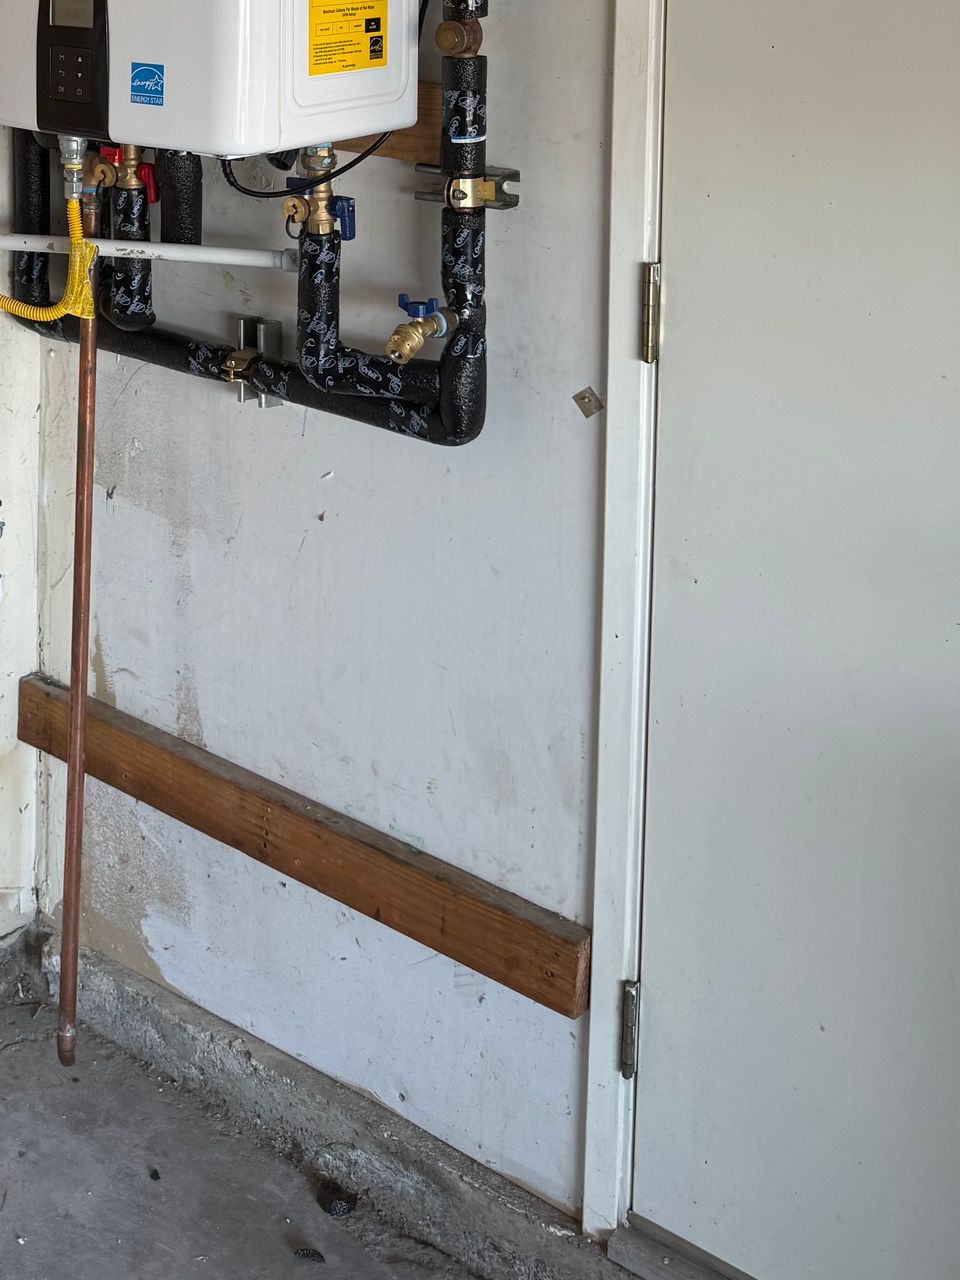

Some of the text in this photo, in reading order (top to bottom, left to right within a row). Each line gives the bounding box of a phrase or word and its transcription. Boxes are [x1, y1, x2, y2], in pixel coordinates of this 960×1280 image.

[150, 97, 163, 105] STAR
[455, 228, 470, 246] Orbit
[473, 235, 485, 255] Orbit
[453, 335, 467, 355] Orbit
[361, 365, 379, 381] Orbit
